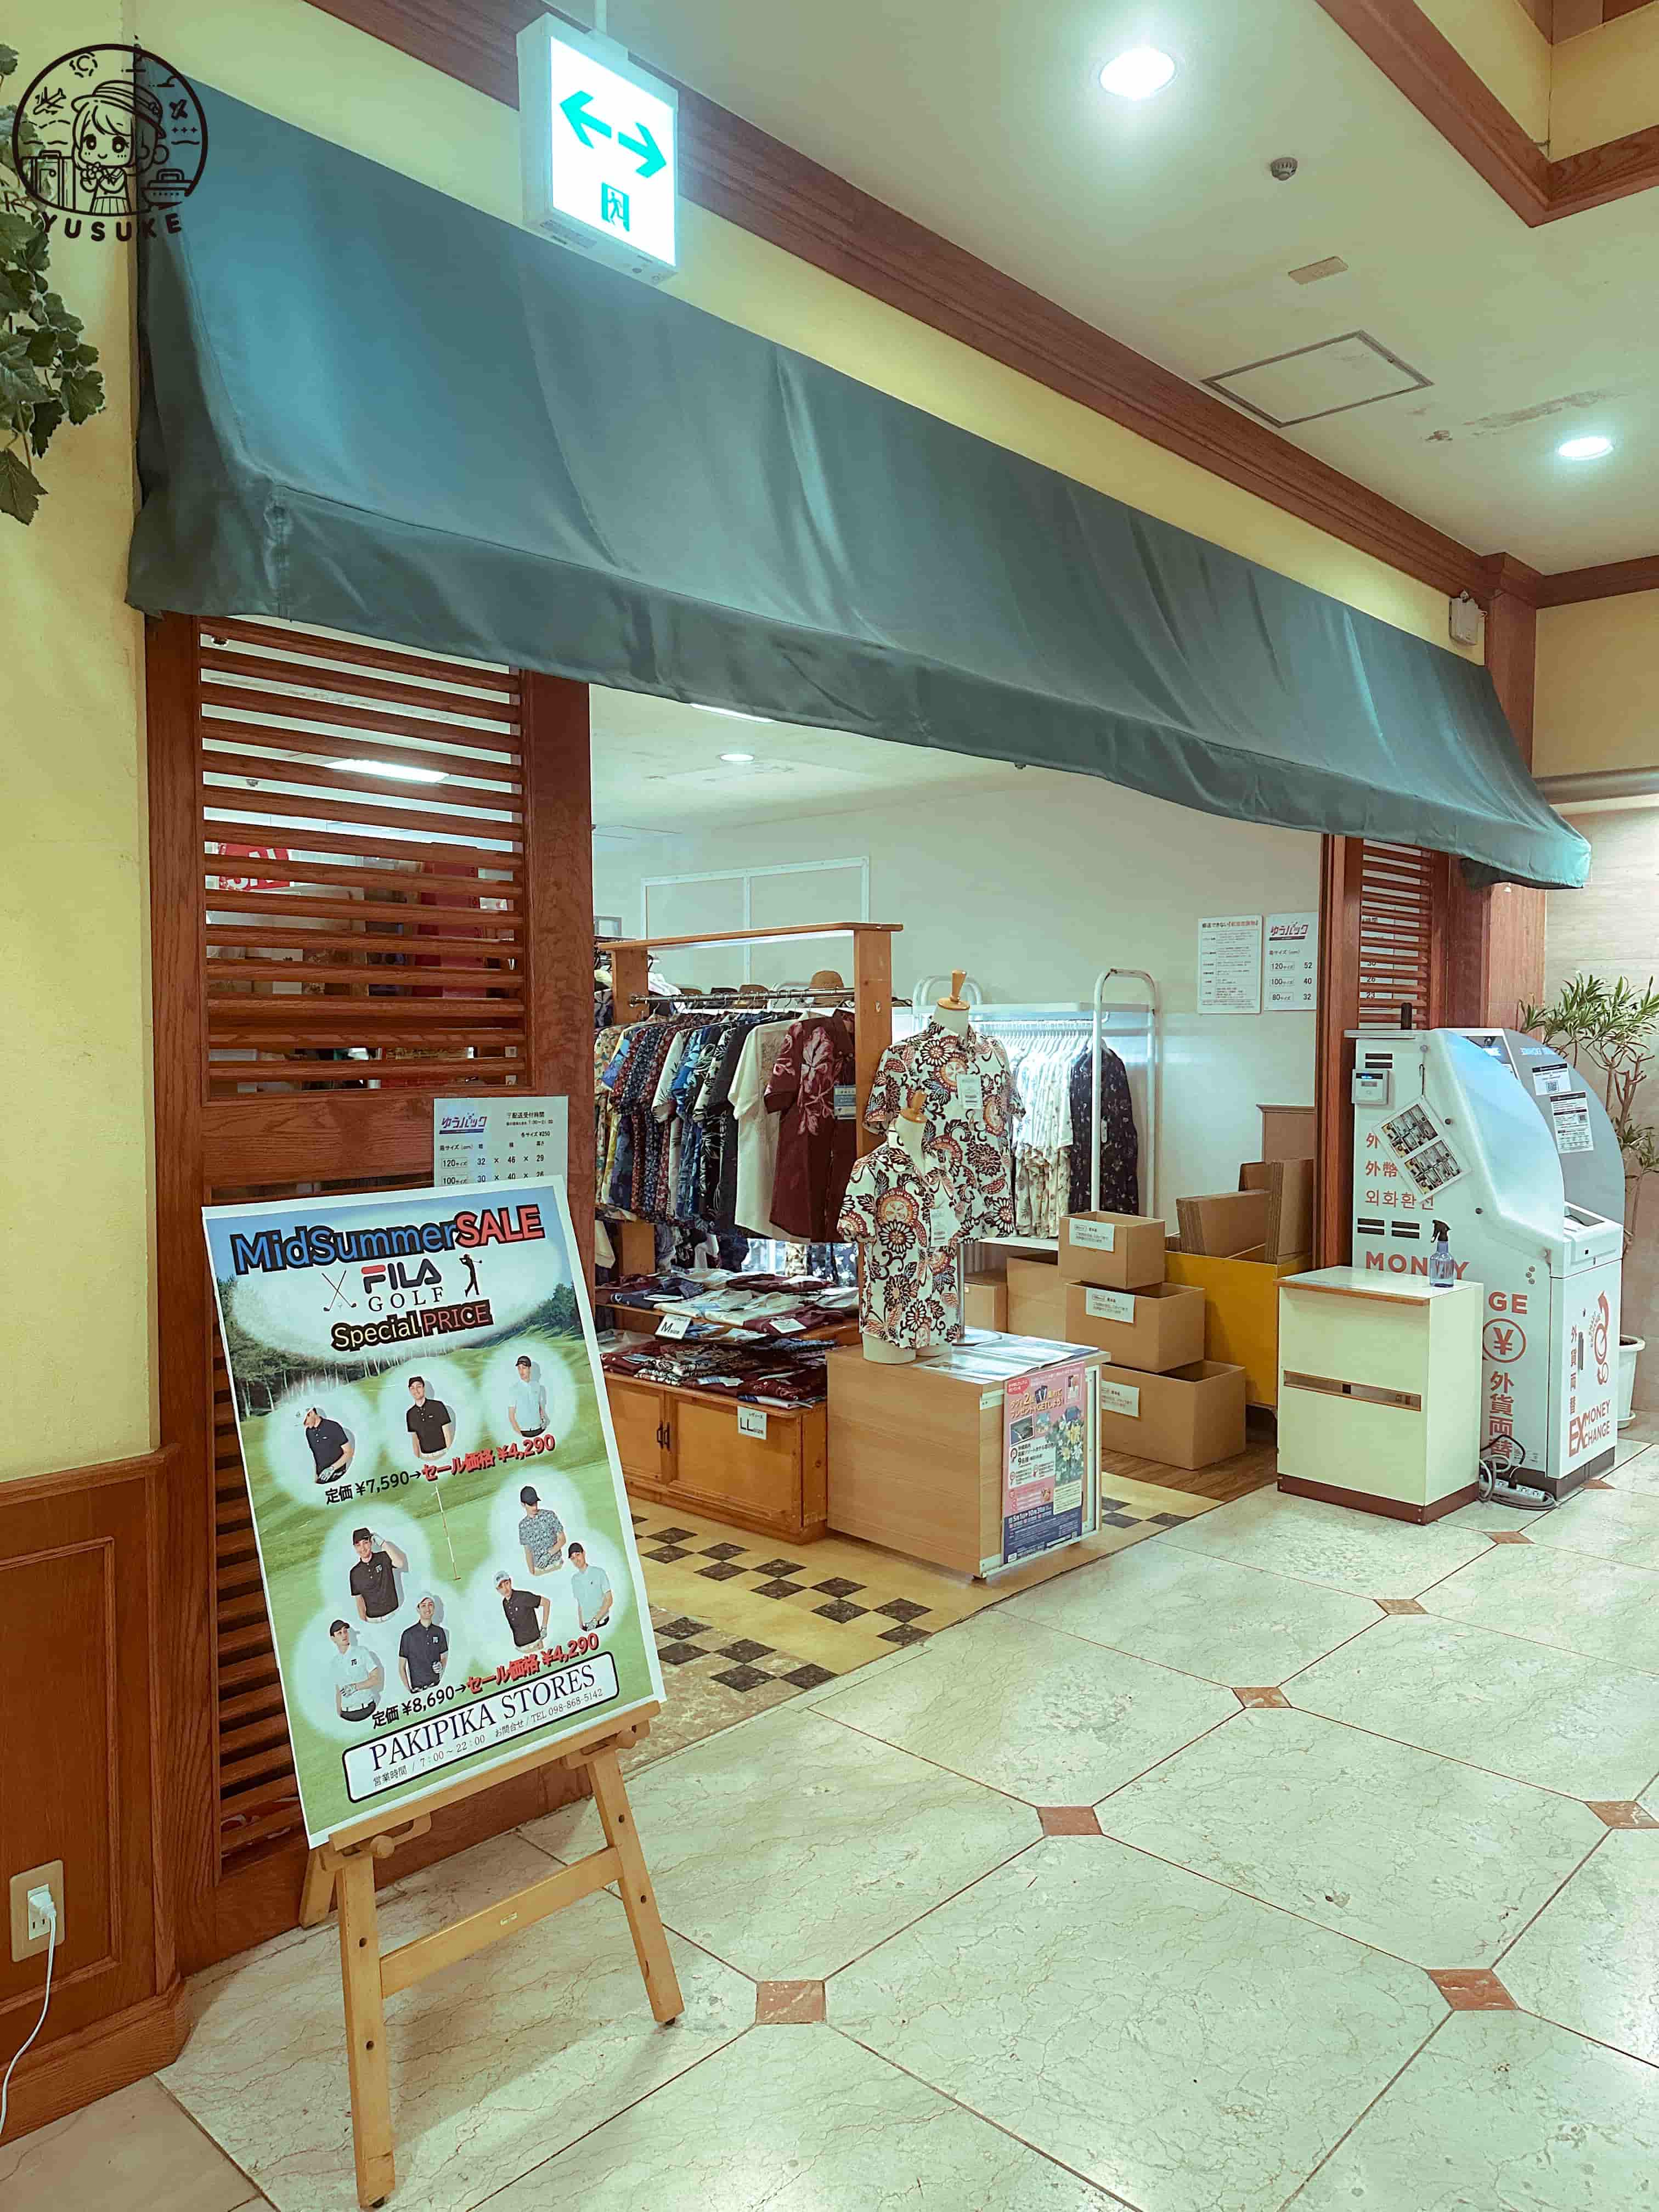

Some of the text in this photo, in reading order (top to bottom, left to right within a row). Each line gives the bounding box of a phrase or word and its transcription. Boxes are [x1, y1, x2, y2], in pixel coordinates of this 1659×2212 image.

[1270, 922, 1309, 936] ゆうパック
[441, 1113, 488, 1128] ゆうパック
[360, 1259, 443, 1294] FILA
[368, 1286, 444, 1312] GOLF
[331, 1300, 493, 1351] Special PRICE
[1489, 1371, 1514, 1462] 外貨両替
[1584, 1400, 1610, 1427] MONEY
[325, 1433, 556, 1505] 定価 ¥7,590 セール価格 ¥4,290
[372, 1632, 600, 1729] 定価 ¥8,690 セール価格 ¥4,290
[370, 1664, 596, 1771] PAKIPIKA STORES
[373, 1765, 408, 1787] 営業時間
[495, 1718, 524, 1739] お問合せ
[531, 1711, 548, 1723] TEL
[548, 1689, 603, 1716] 098-868-5142
